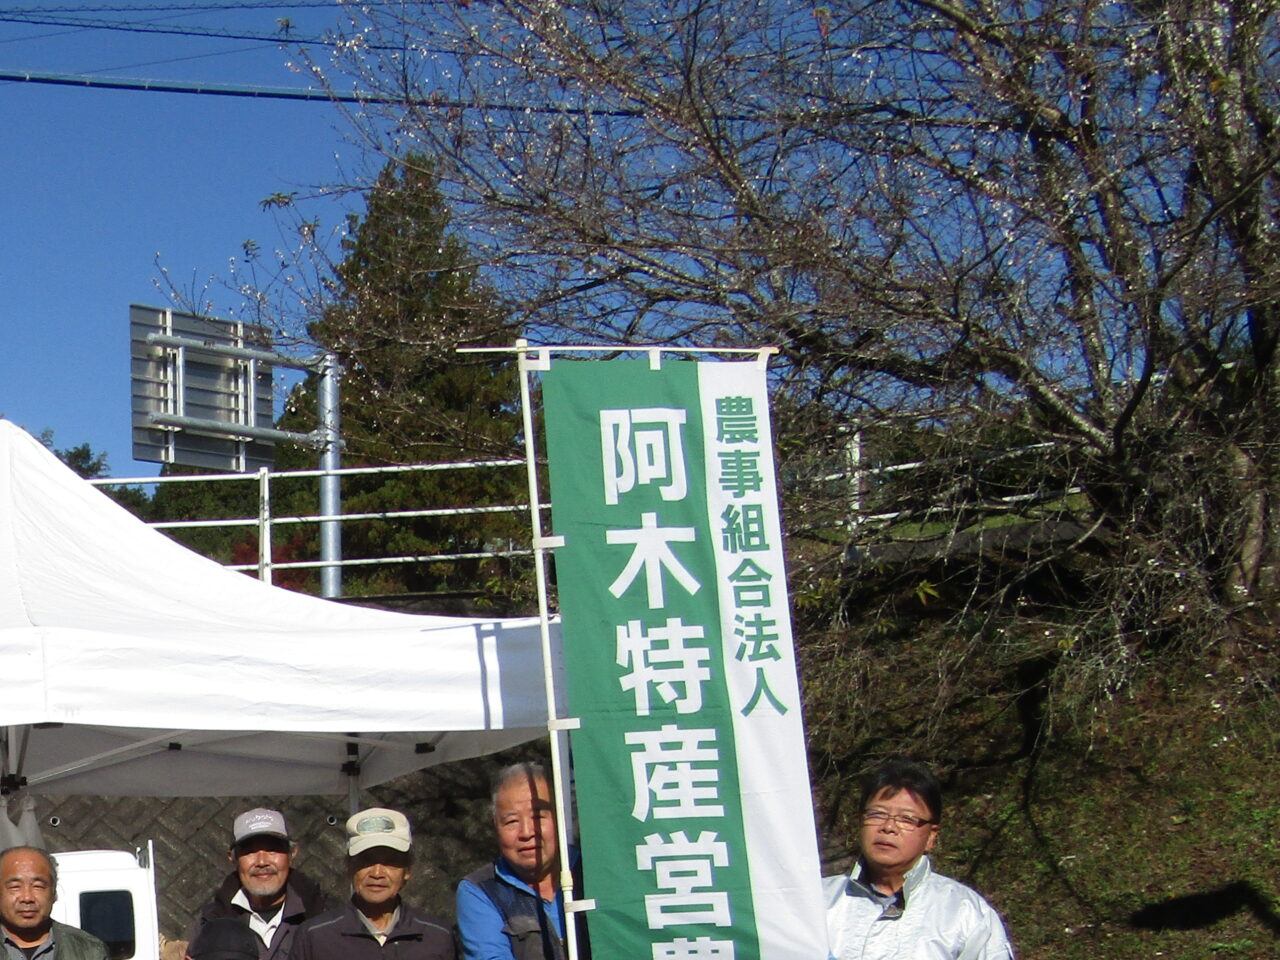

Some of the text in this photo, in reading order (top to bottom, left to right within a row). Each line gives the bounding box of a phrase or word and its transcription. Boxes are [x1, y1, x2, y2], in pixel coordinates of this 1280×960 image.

[715, 395, 789, 718] 農事組合法人
